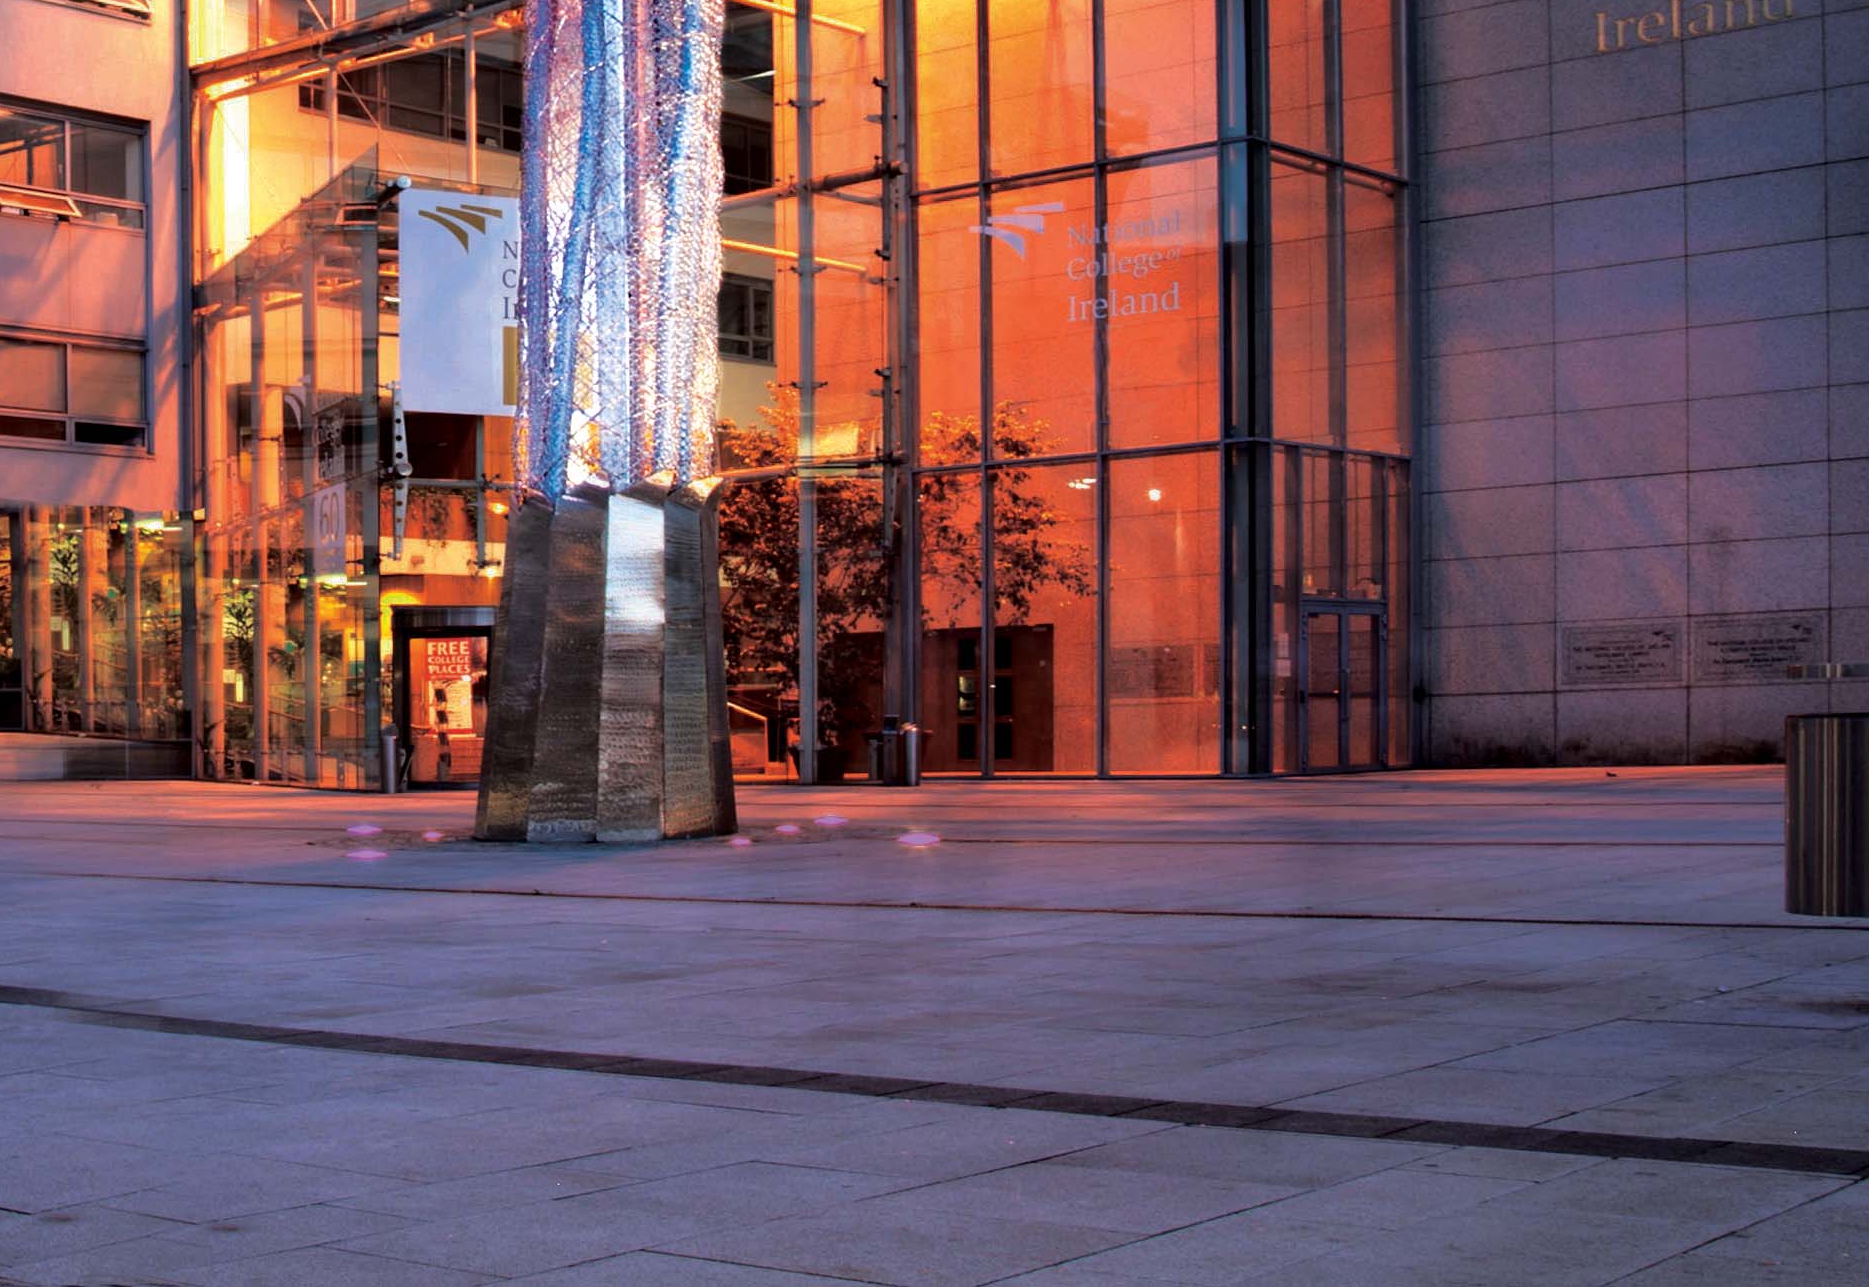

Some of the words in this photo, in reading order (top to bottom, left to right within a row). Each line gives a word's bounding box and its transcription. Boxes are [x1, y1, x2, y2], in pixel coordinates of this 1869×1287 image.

[1067, 209, 1181, 250] National
[1066, 249, 1164, 281] College
[1067, 280, 1181, 323] Ireland
[427, 641, 470, 656] FREE
[427, 656, 470, 664] COLLEGE
[427, 664, 471, 674] PLACES
